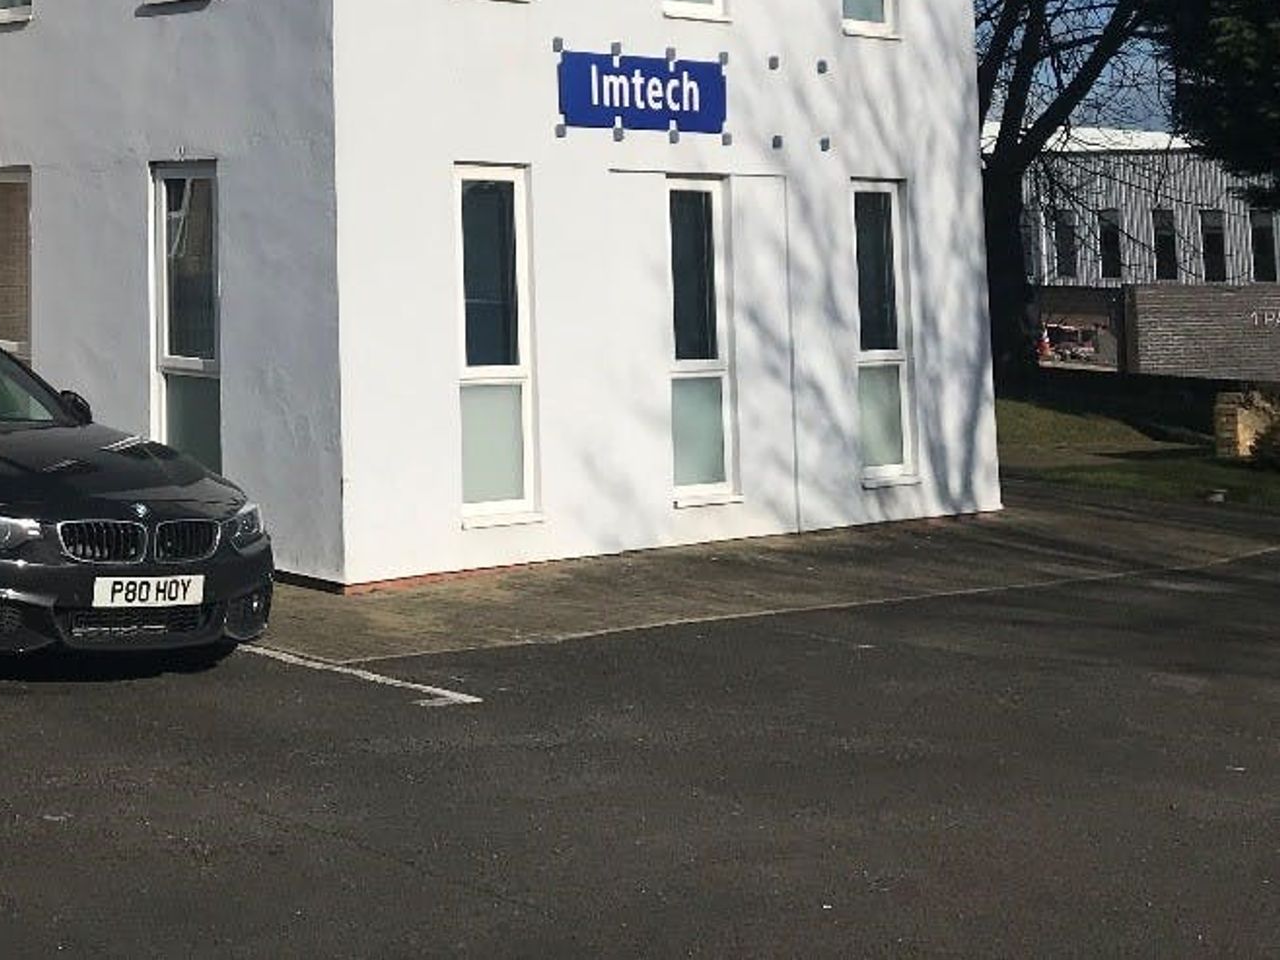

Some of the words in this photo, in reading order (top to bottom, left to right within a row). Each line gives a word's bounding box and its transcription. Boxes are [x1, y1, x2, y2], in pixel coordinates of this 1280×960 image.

[590, 63, 700, 112] Imtech
[111, 581, 150, 603] P80
[155, 579, 191, 602] HOY
